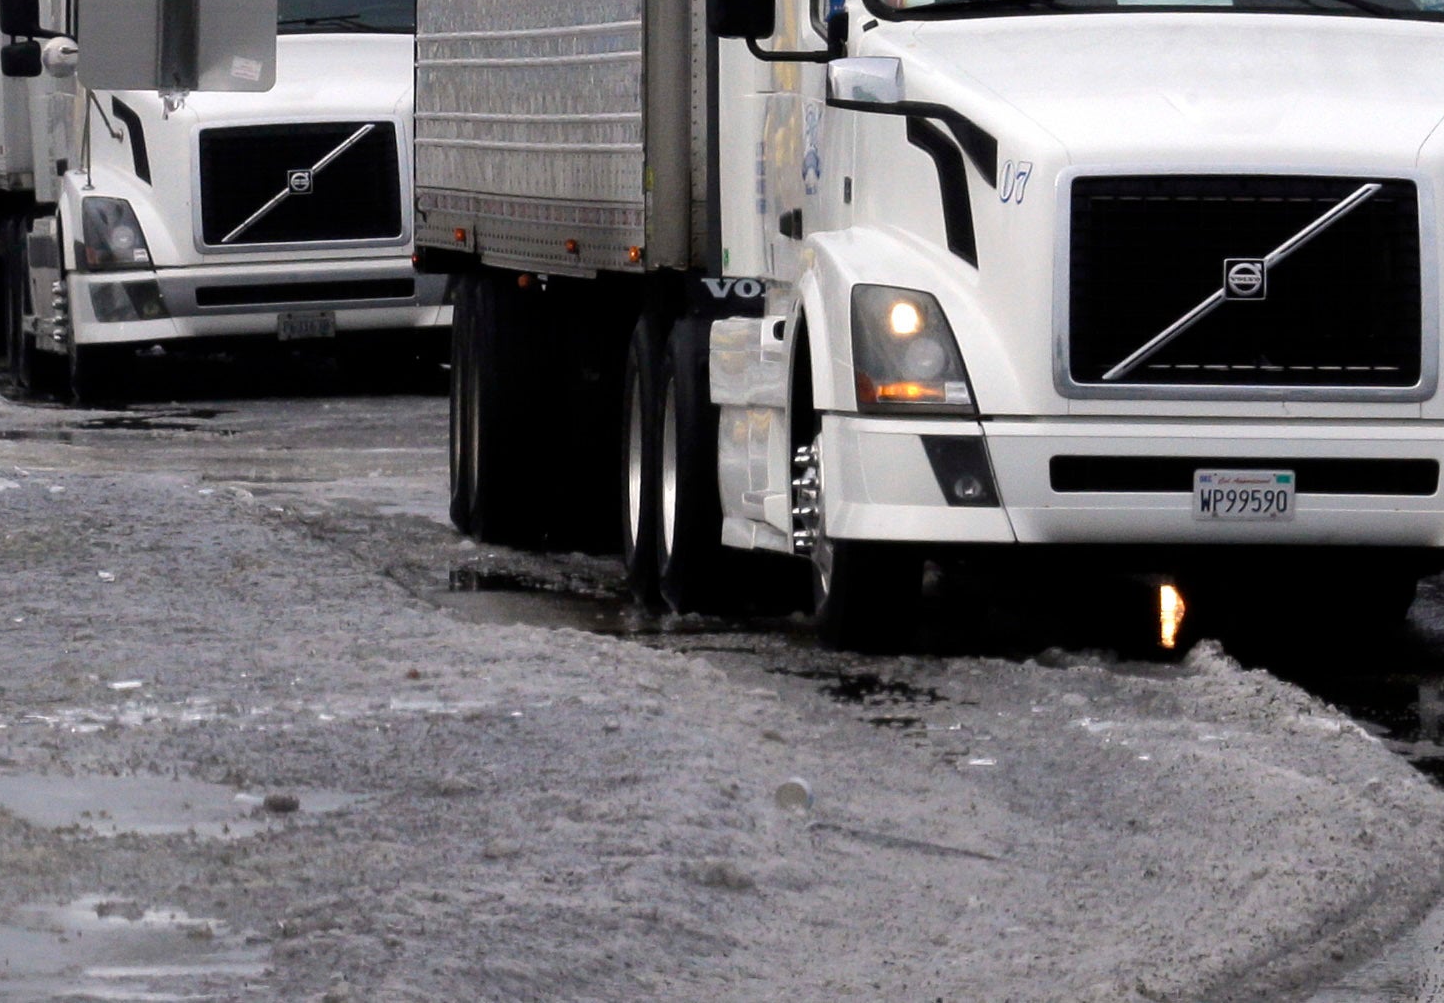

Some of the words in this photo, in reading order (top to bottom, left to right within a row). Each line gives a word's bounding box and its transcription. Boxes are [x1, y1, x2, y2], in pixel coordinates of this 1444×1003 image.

[999, 159, 1033, 205] 07
[701, 278, 765, 298] VO
[1200, 489, 1288, 513] WP99590
